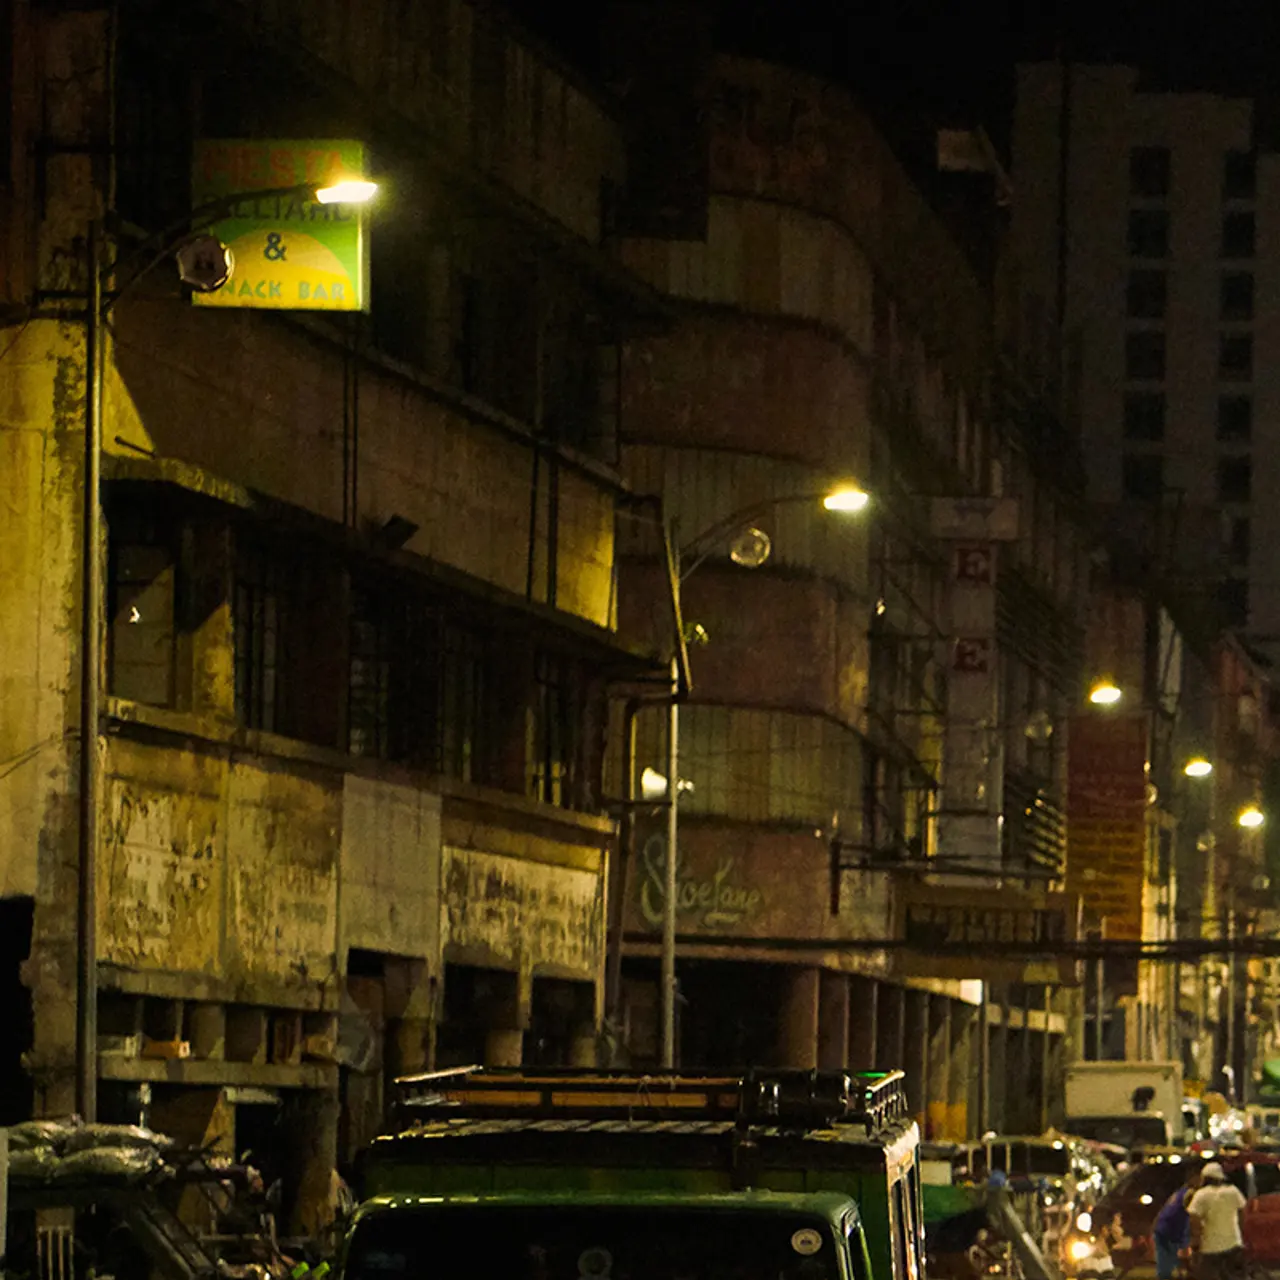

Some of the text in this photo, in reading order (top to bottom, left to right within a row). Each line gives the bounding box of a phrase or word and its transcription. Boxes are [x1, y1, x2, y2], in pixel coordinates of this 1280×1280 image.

[264, 232, 287, 262] &
[220, 278, 346, 301] NACK BAR
